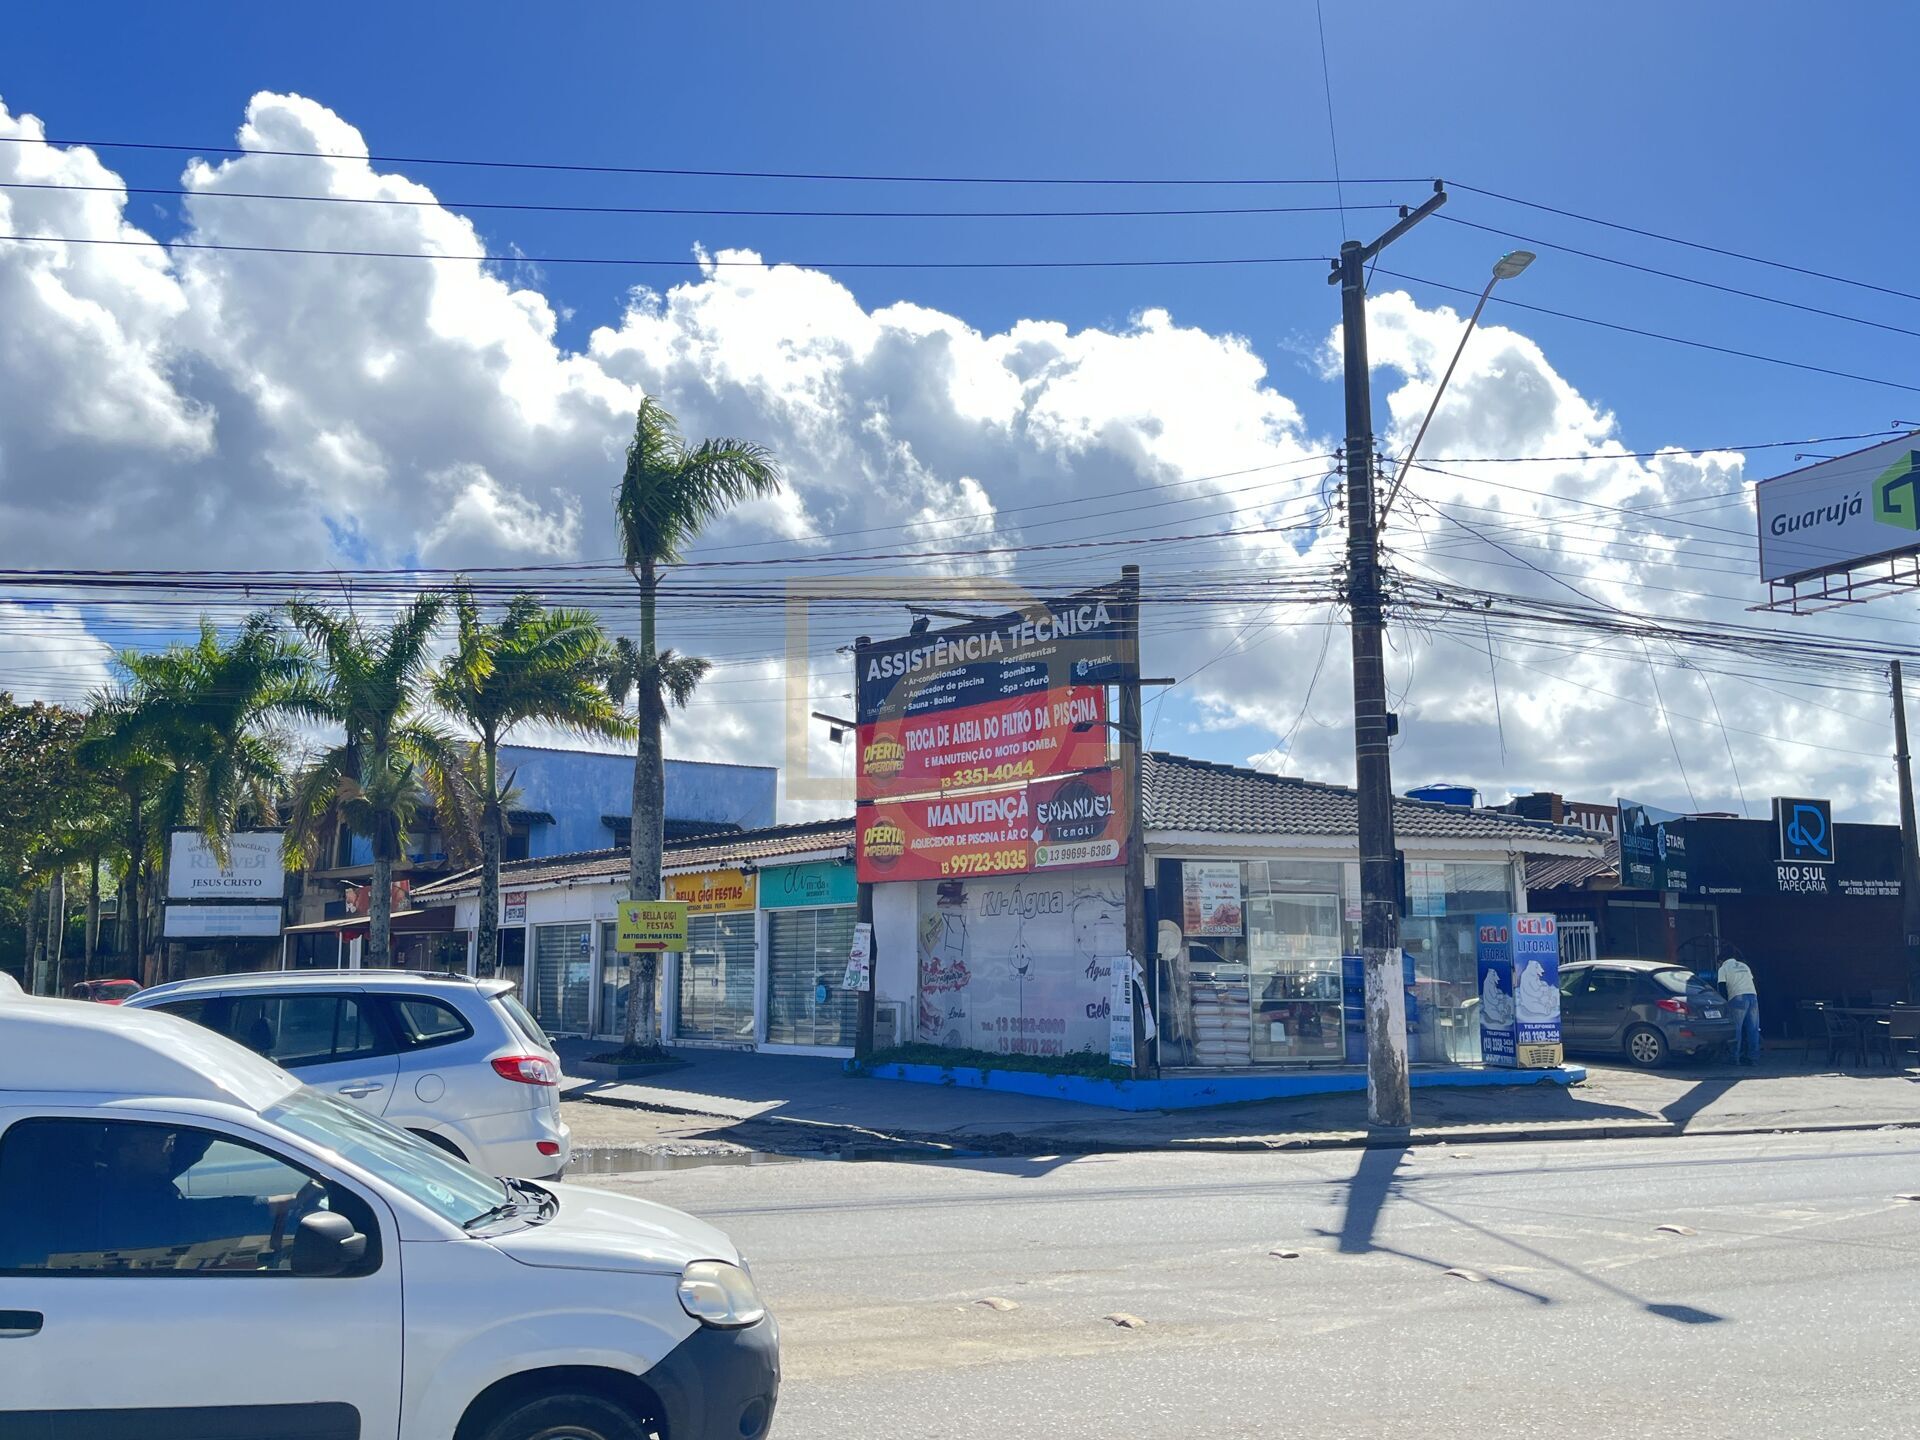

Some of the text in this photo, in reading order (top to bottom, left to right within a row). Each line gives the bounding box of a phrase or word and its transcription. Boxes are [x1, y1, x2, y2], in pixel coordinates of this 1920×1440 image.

[1771, 491, 1862, 536] Guarujá
[867, 600, 1112, 682] ASSISTÊNCIA TÉCNICA
[1003, 646, 1057, 665] Ferramentas
[1088, 655, 1112, 667] STARK
[909, 667, 967, 685] Ar-condicionado
[1003, 665, 1036, 680] Bombas
[909, 677, 985, 699] Aquecedor de piscina
[1003, 684, 1018, 694] Spa
[908, 701, 929, 711] Sauna
[905, 696, 1098, 752] TROCA DE AREIA DO FILTRO DA PISCINA
[864, 742, 906, 763] OFERTAS
[925, 736, 1058, 768] E MANUTENÇÃO MOTO BOMBA
[941, 759, 1035, 788] 13 3351-4044
[1036, 794, 1116, 824] EMANUEL
[864, 825, 906, 846] OFERTAS
[911, 835, 955, 850] AQUECEDOR
[956, 834, 967, 846] DE
[968, 831, 1000, 845] PISCINA
[1006, 828, 1019, 842] AR
[1665, 834, 1686, 850] STARK
[1049, 843, 1113, 862] 13 99699-6386
[941, 849, 1027, 875] 13 99723-3035
[1777, 866, 1826, 881] RIO SUL
[190, 879, 263, 889] JESUS CRISTO
[1777, 879, 1827, 895] TAPEÇARIA
[675, 886, 743, 902] BELLA GIGI FESTAS
[642, 911, 677, 920] BELLA GIGI
[646, 921, 675, 930] FESTAS
[1517, 919, 1555, 935] GELO
[1480, 926, 1508, 943] GELO
[1480, 949, 1508, 961] LITORAL
[1517, 940, 1556, 953] LITORAL
[1085, 954, 1111, 981] Água
